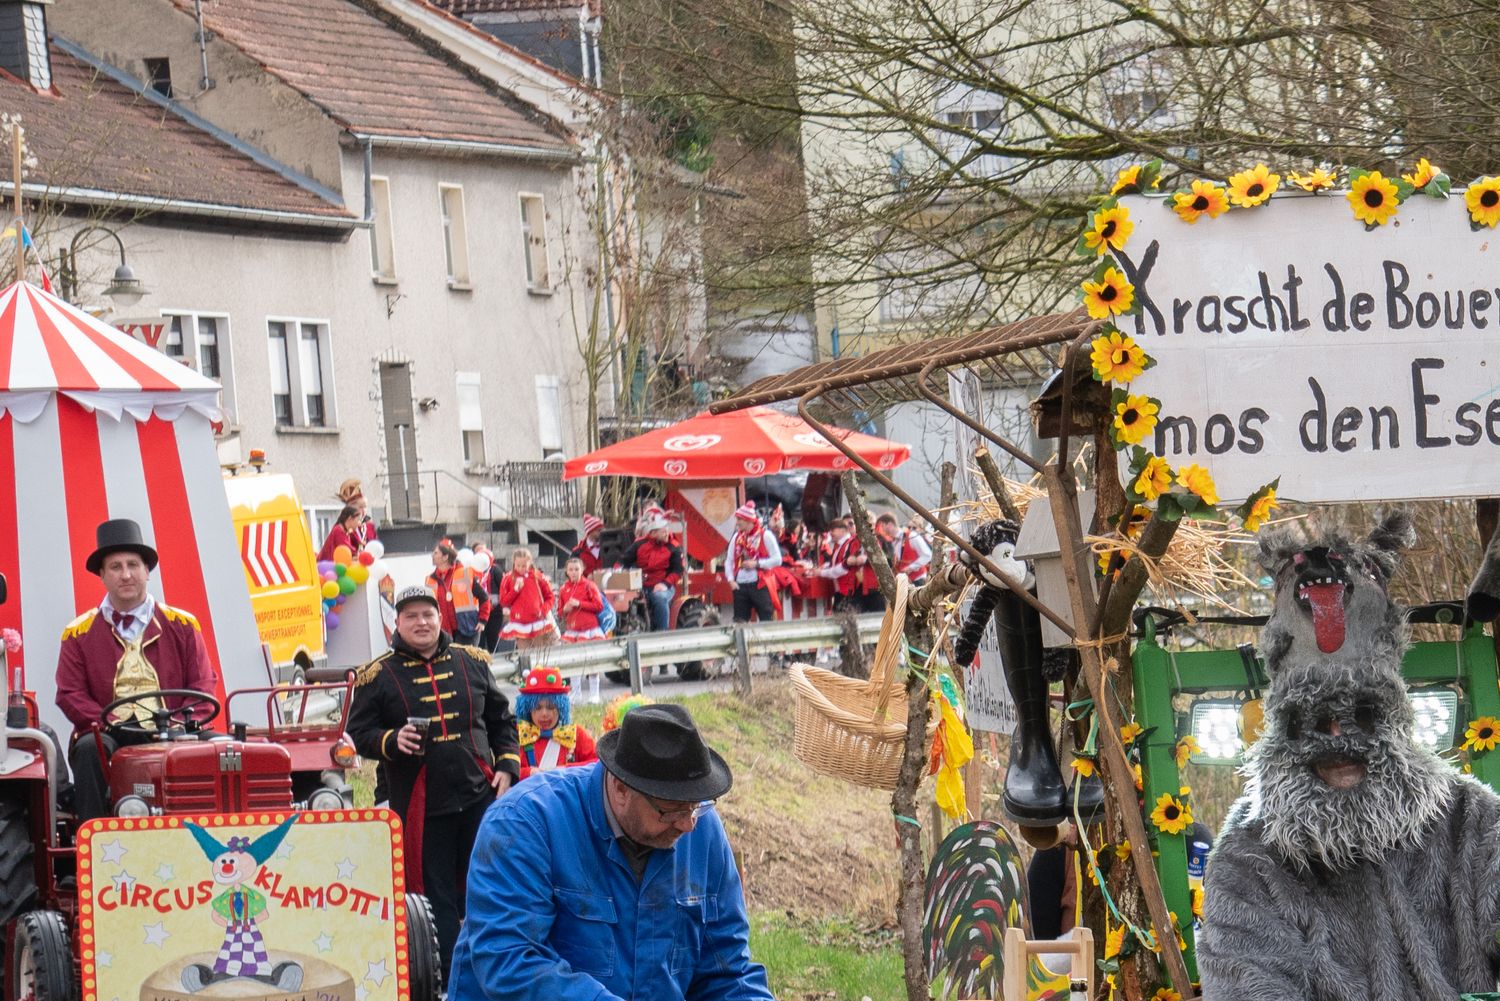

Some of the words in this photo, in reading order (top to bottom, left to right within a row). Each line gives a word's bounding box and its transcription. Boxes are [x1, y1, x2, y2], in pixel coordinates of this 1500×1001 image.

[1322, 261, 1376, 333] de
[1153, 407, 1270, 457] mos
[1299, 376, 1400, 453] den
[97, 880, 215, 914] CIRCUS
